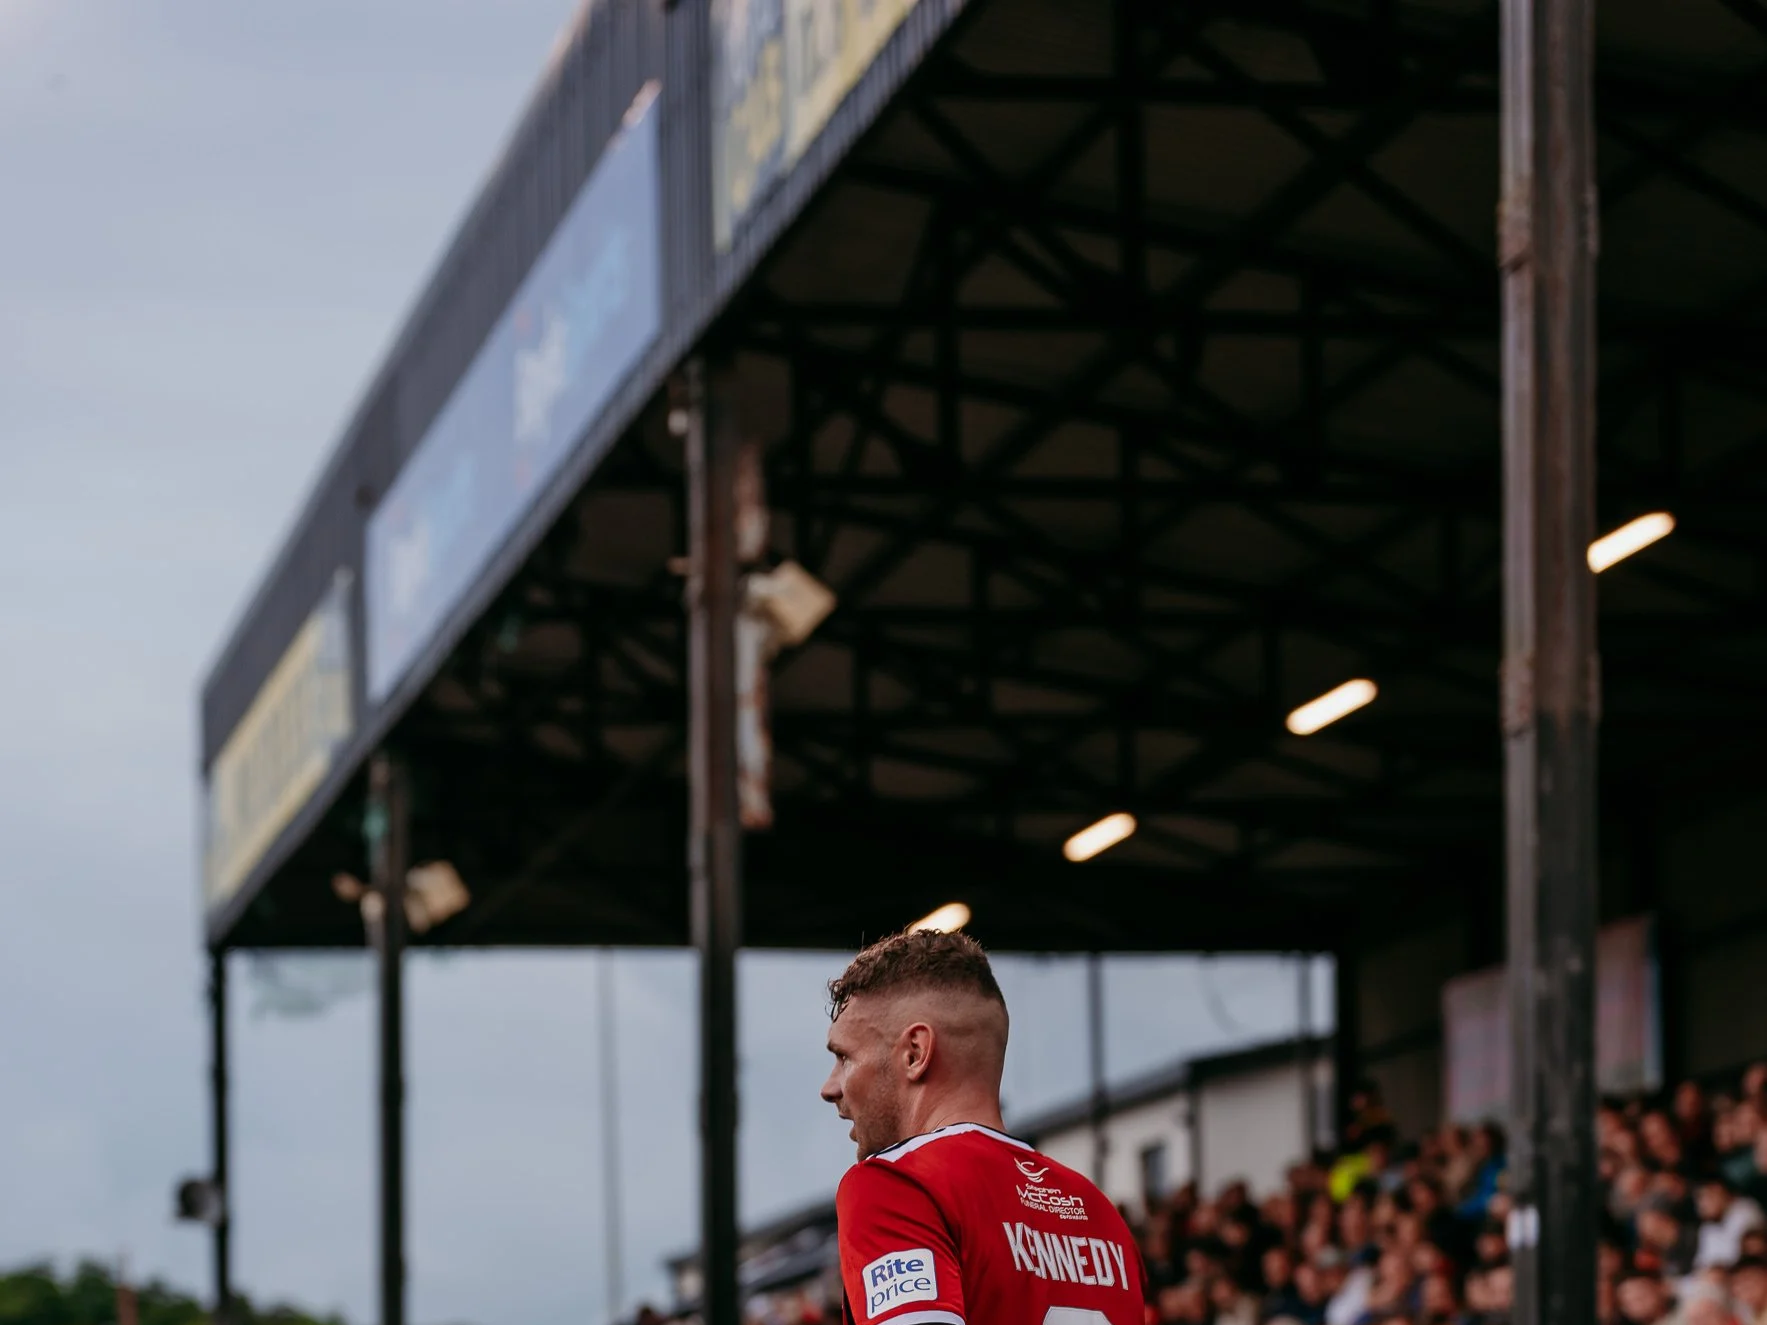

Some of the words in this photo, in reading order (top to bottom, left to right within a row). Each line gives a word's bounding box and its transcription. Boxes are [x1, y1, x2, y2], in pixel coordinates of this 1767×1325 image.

[1020, 1197, 1049, 1212] FUNERAL
[1048, 1205, 1086, 1215] DIRECTOR
[871, 1258, 924, 1288] Rite
[1002, 1222, 1129, 1291] KENNEDY
[871, 1277, 931, 1314] price
